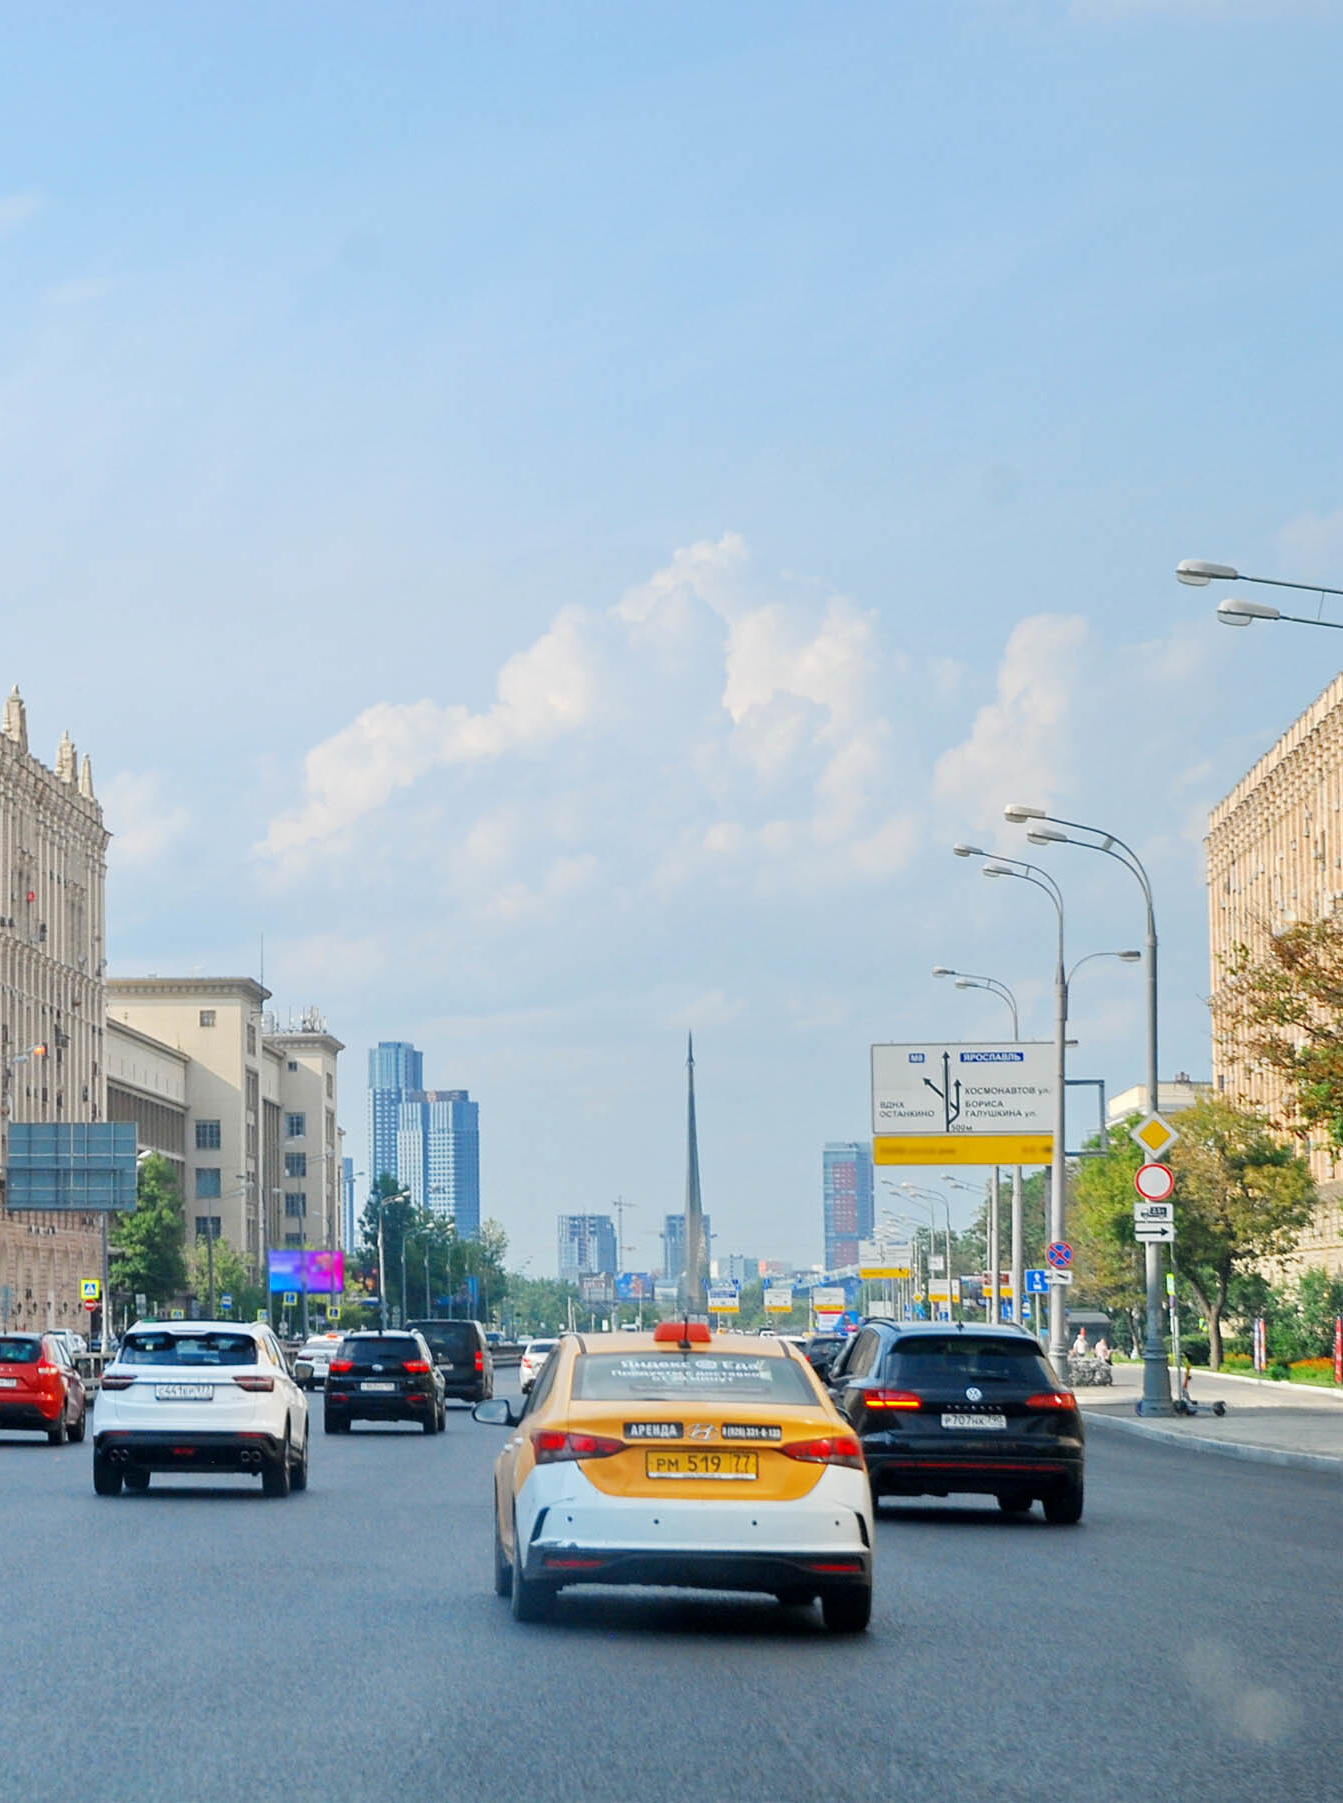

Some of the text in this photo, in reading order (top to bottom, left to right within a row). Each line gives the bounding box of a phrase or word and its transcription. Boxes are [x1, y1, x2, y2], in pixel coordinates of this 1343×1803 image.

[963, 1053, 1021, 1062] ЯРОСЛАВЛЬ
[964, 1086, 1035, 1095] КОСМОНАВТОВ
[965, 1100, 1004, 1108] БОРИСА
[879, 1110, 935, 1118] ОСТАНКИНО
[965, 1110, 1022, 1118] ГАЛУШКИНА
[621, 1360, 691, 1370] Яндекс
[630, 1424, 677, 1436] АРЕНДА
[656, 1455, 751, 1473] РМ 519 77
